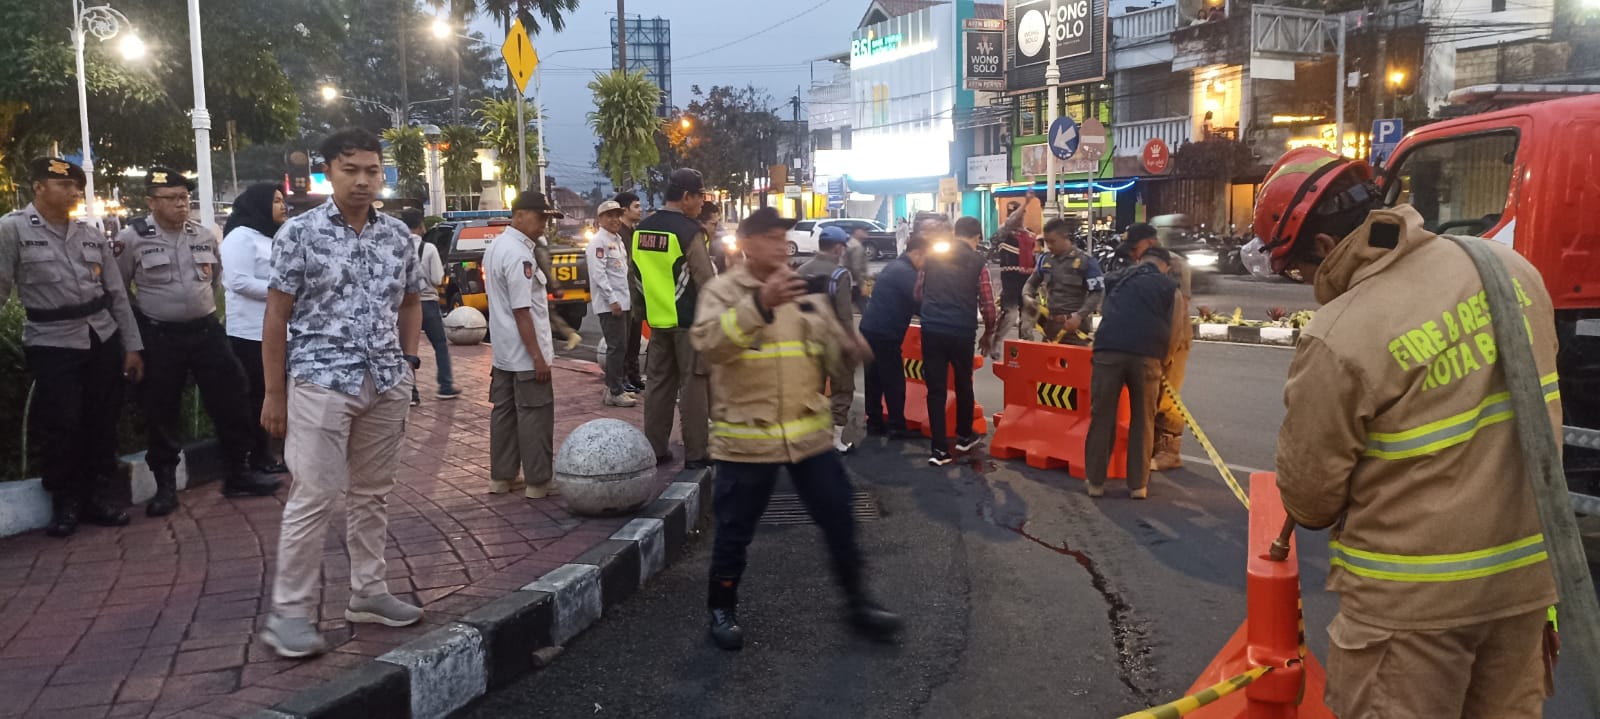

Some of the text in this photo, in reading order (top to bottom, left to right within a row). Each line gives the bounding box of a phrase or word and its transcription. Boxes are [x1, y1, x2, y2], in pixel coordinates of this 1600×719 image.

[1047, 19, 1084, 43] OLO
[851, 37, 872, 58] BSI
[970, 55, 999, 64] WONG
[973, 64, 997, 73] SOLO
[1379, 121, 1395, 143] P
[551, 265, 578, 281] ISI
[1388, 320, 1447, 372] FIRE
[1442, 311, 1460, 343] &
[1421, 342, 1481, 392] KOTA
